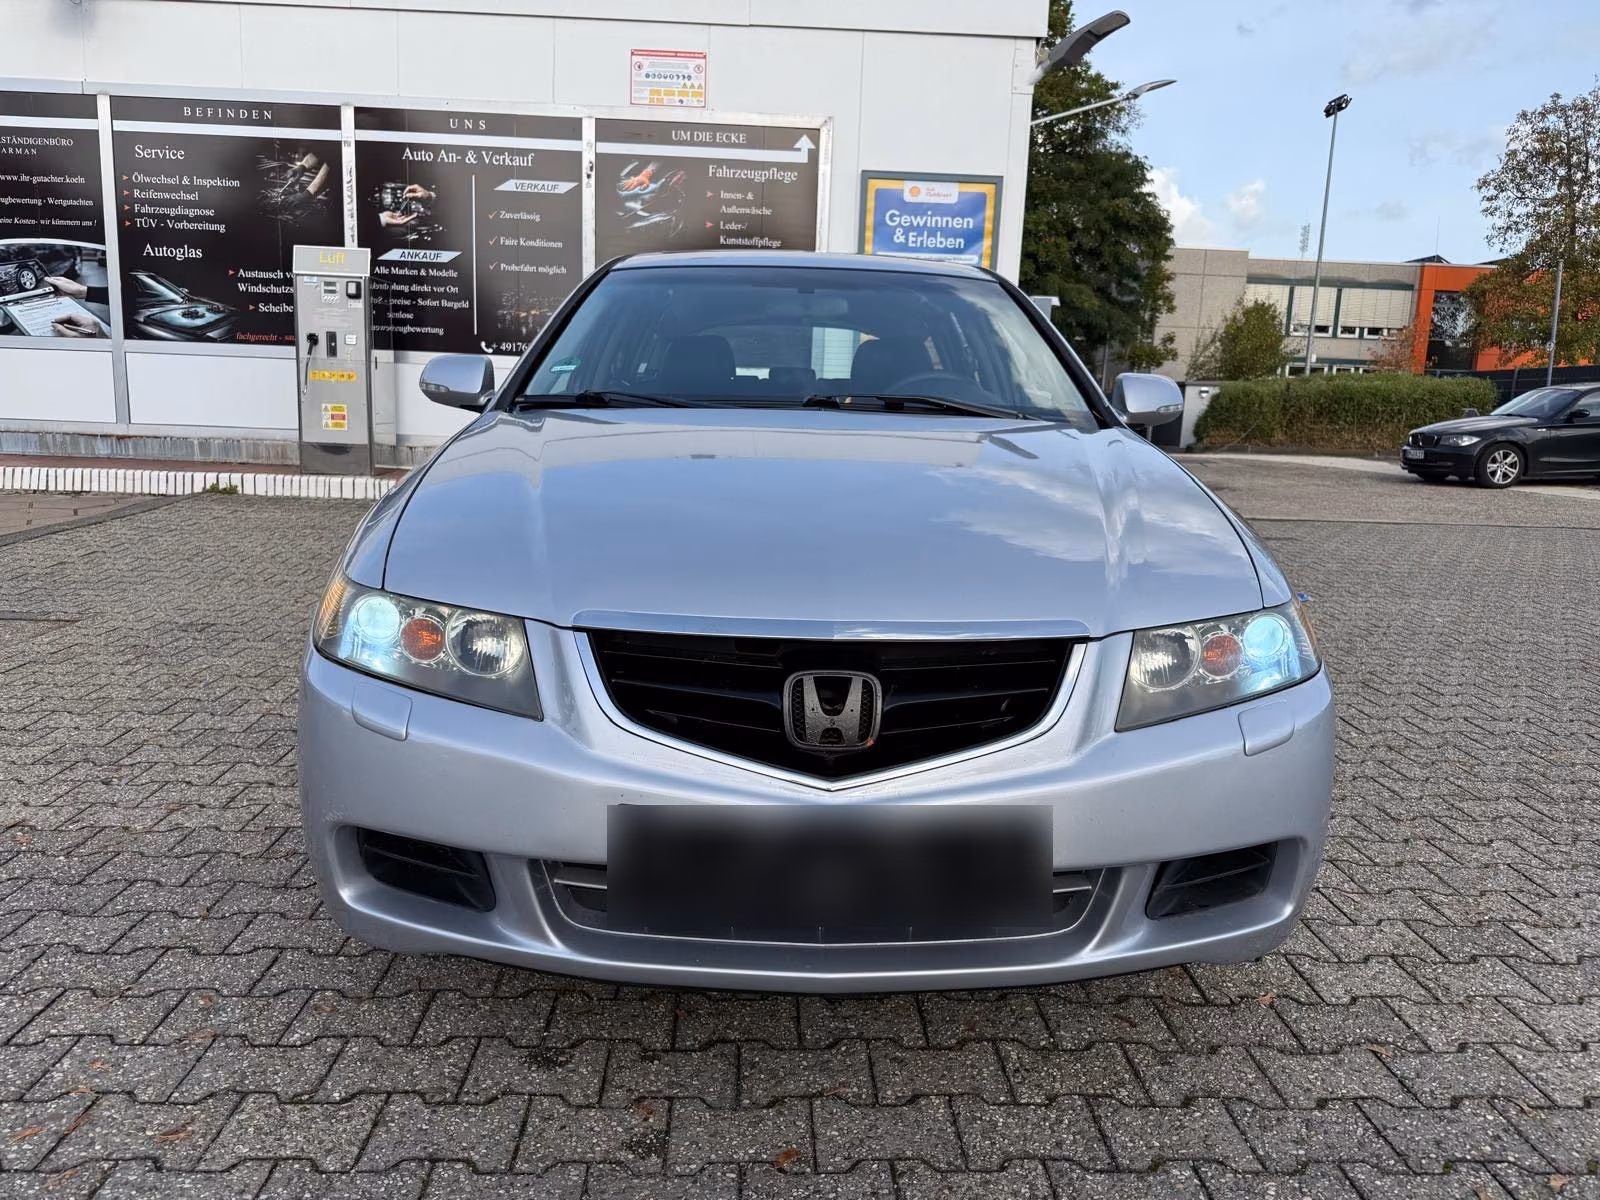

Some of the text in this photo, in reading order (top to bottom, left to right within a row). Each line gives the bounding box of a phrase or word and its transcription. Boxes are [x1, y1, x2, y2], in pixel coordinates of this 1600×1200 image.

[183, 106, 272, 120] BEFINDEN
[449, 118, 486, 130] UNS
[0, 135, 73, 146] STÄNDIGENBÜRO
[672, 130, 747, 144] UM DIE ECKE
[134, 144, 185, 160] Service
[402, 147, 535, 167] Auto An- & Verkauf
[708, 164, 798, 183] Fahrzeugpflege
[132, 172, 240, 188] Ölwechsel & Inspektion
[514, 182, 560, 192] VERKAUF
[133, 189, 199, 201] Reifenwechsel
[720, 190, 754, 200] Innen- &
[47, 197, 94, 207] Wertgutachten
[134, 203, 215, 217] Fahrzeugdiagnose
[499, 210, 541, 222] Zuverlässig
[720, 205, 773, 215] Außenwäsche
[40, 217, 50, 225] wir
[51, 217, 80, 226] kümmern
[134, 216, 157, 228] TÜV
[167, 219, 226, 233] Vorbereitung
[885, 209, 974, 229] Gewinnen
[500, 236, 563, 248] Faire Konditionen
[719, 235, 782, 248] Kunststoffpflege
[893, 228, 965, 249] & Erleben
[142, 243, 203, 260] Autoglas
[319, 251, 345, 264] Luft
[399, 250, 443, 261] ANKAUF
[237, 268, 283, 279] Austausch
[373, 266, 458, 278] Alle Marken & Modelle
[500, 263, 567, 275] Probefahrt möglich
[410, 284, 431, 292] direkt
[446, 285, 459, 293] Ort
[258, 303, 294, 313] Scheibe
[417, 298, 440, 307] Sofort
[441, 299, 469, 310] Bargeld
[236, 332, 277, 341] fachgerecht
